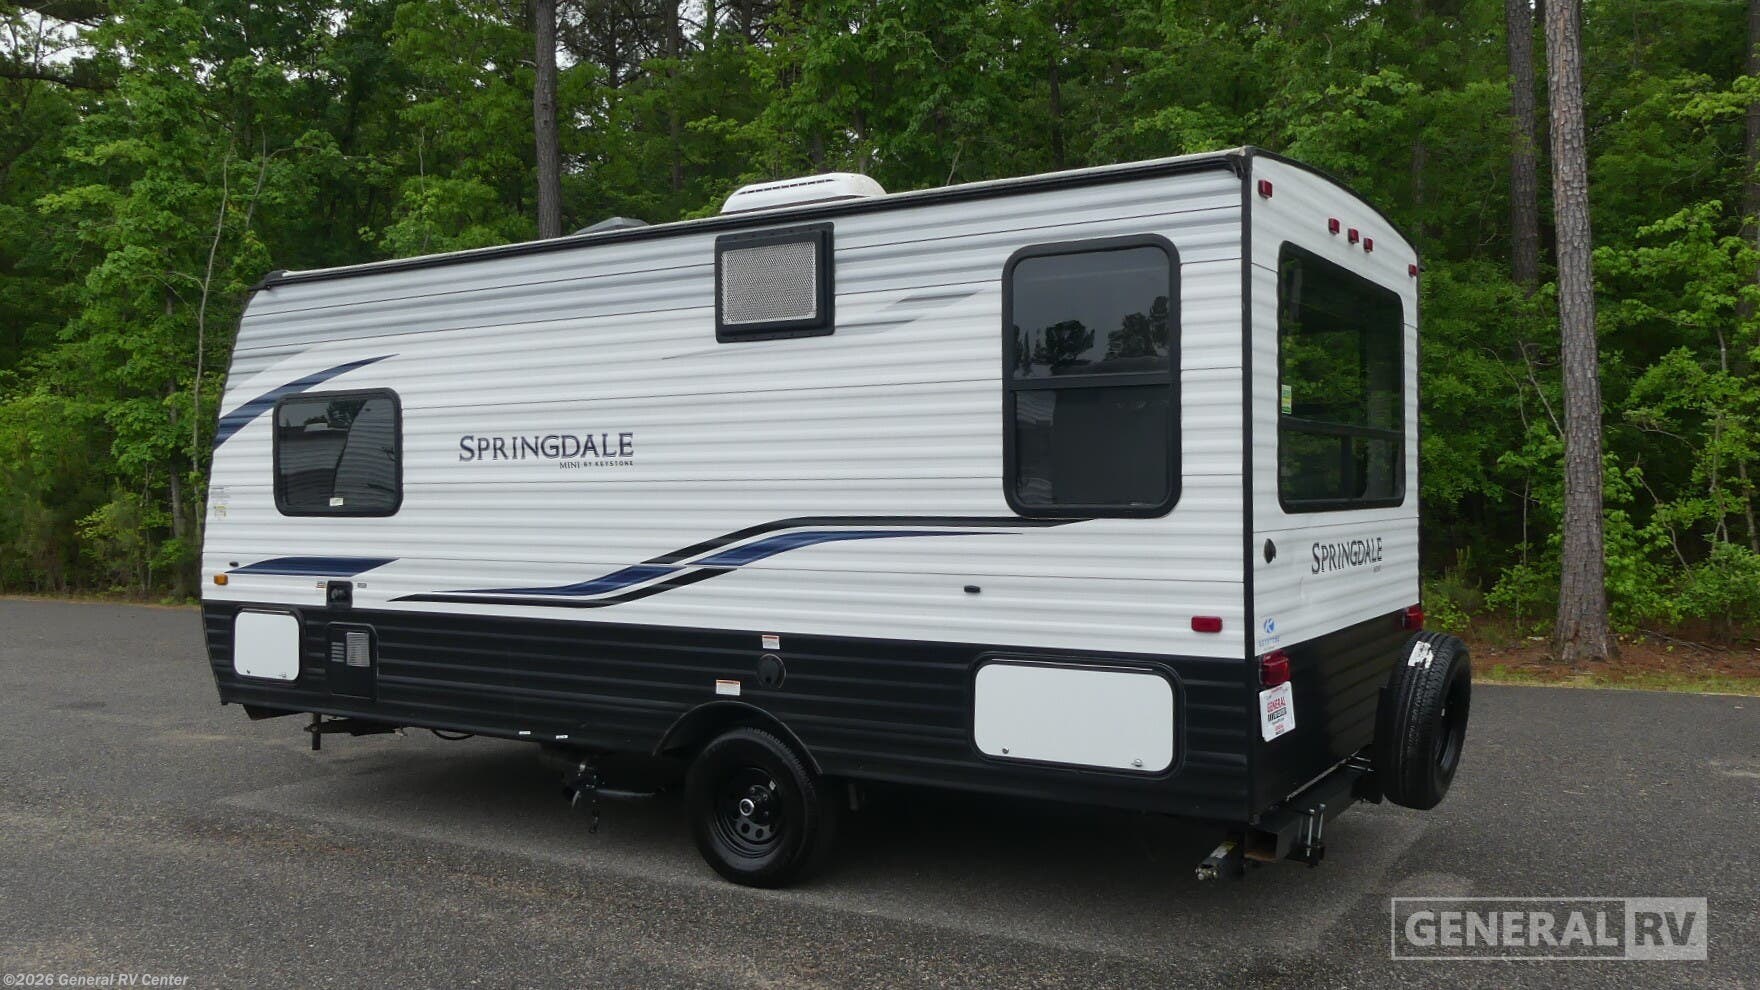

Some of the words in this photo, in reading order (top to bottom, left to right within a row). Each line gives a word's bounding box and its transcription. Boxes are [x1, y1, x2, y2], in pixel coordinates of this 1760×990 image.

[459, 432, 635, 462] SPRINGDALE
[559, 461, 580, 469] MINI
[1311, 537, 1382, 575] SPRINGDALE
